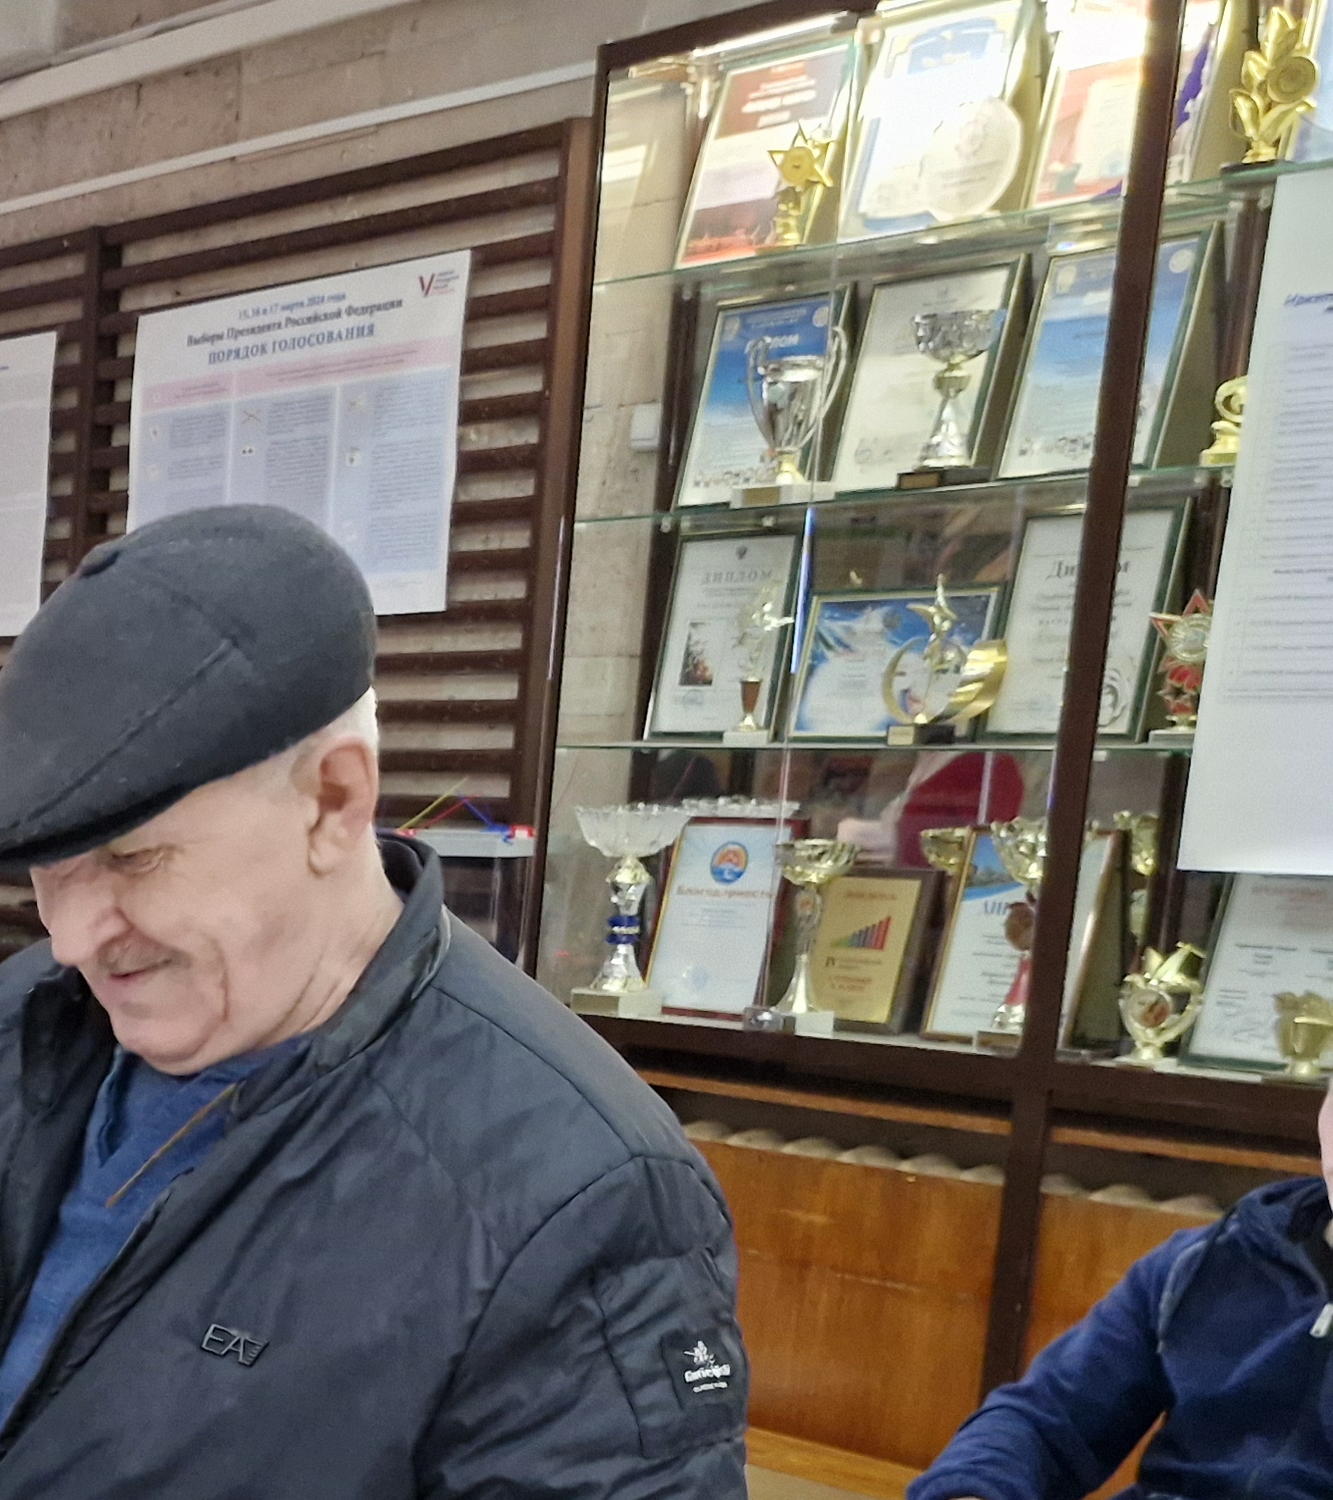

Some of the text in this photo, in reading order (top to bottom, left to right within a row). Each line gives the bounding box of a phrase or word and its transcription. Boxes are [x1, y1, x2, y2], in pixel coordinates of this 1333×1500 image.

[226, 320, 282, 342] Президента
[284, 307, 342, 329] Российской
[344, 298, 403, 319] Федерации
[208, 342, 268, 366] ПОРЯДОК
[271, 322, 375, 354] ГОЛОСОВАНИЯ
